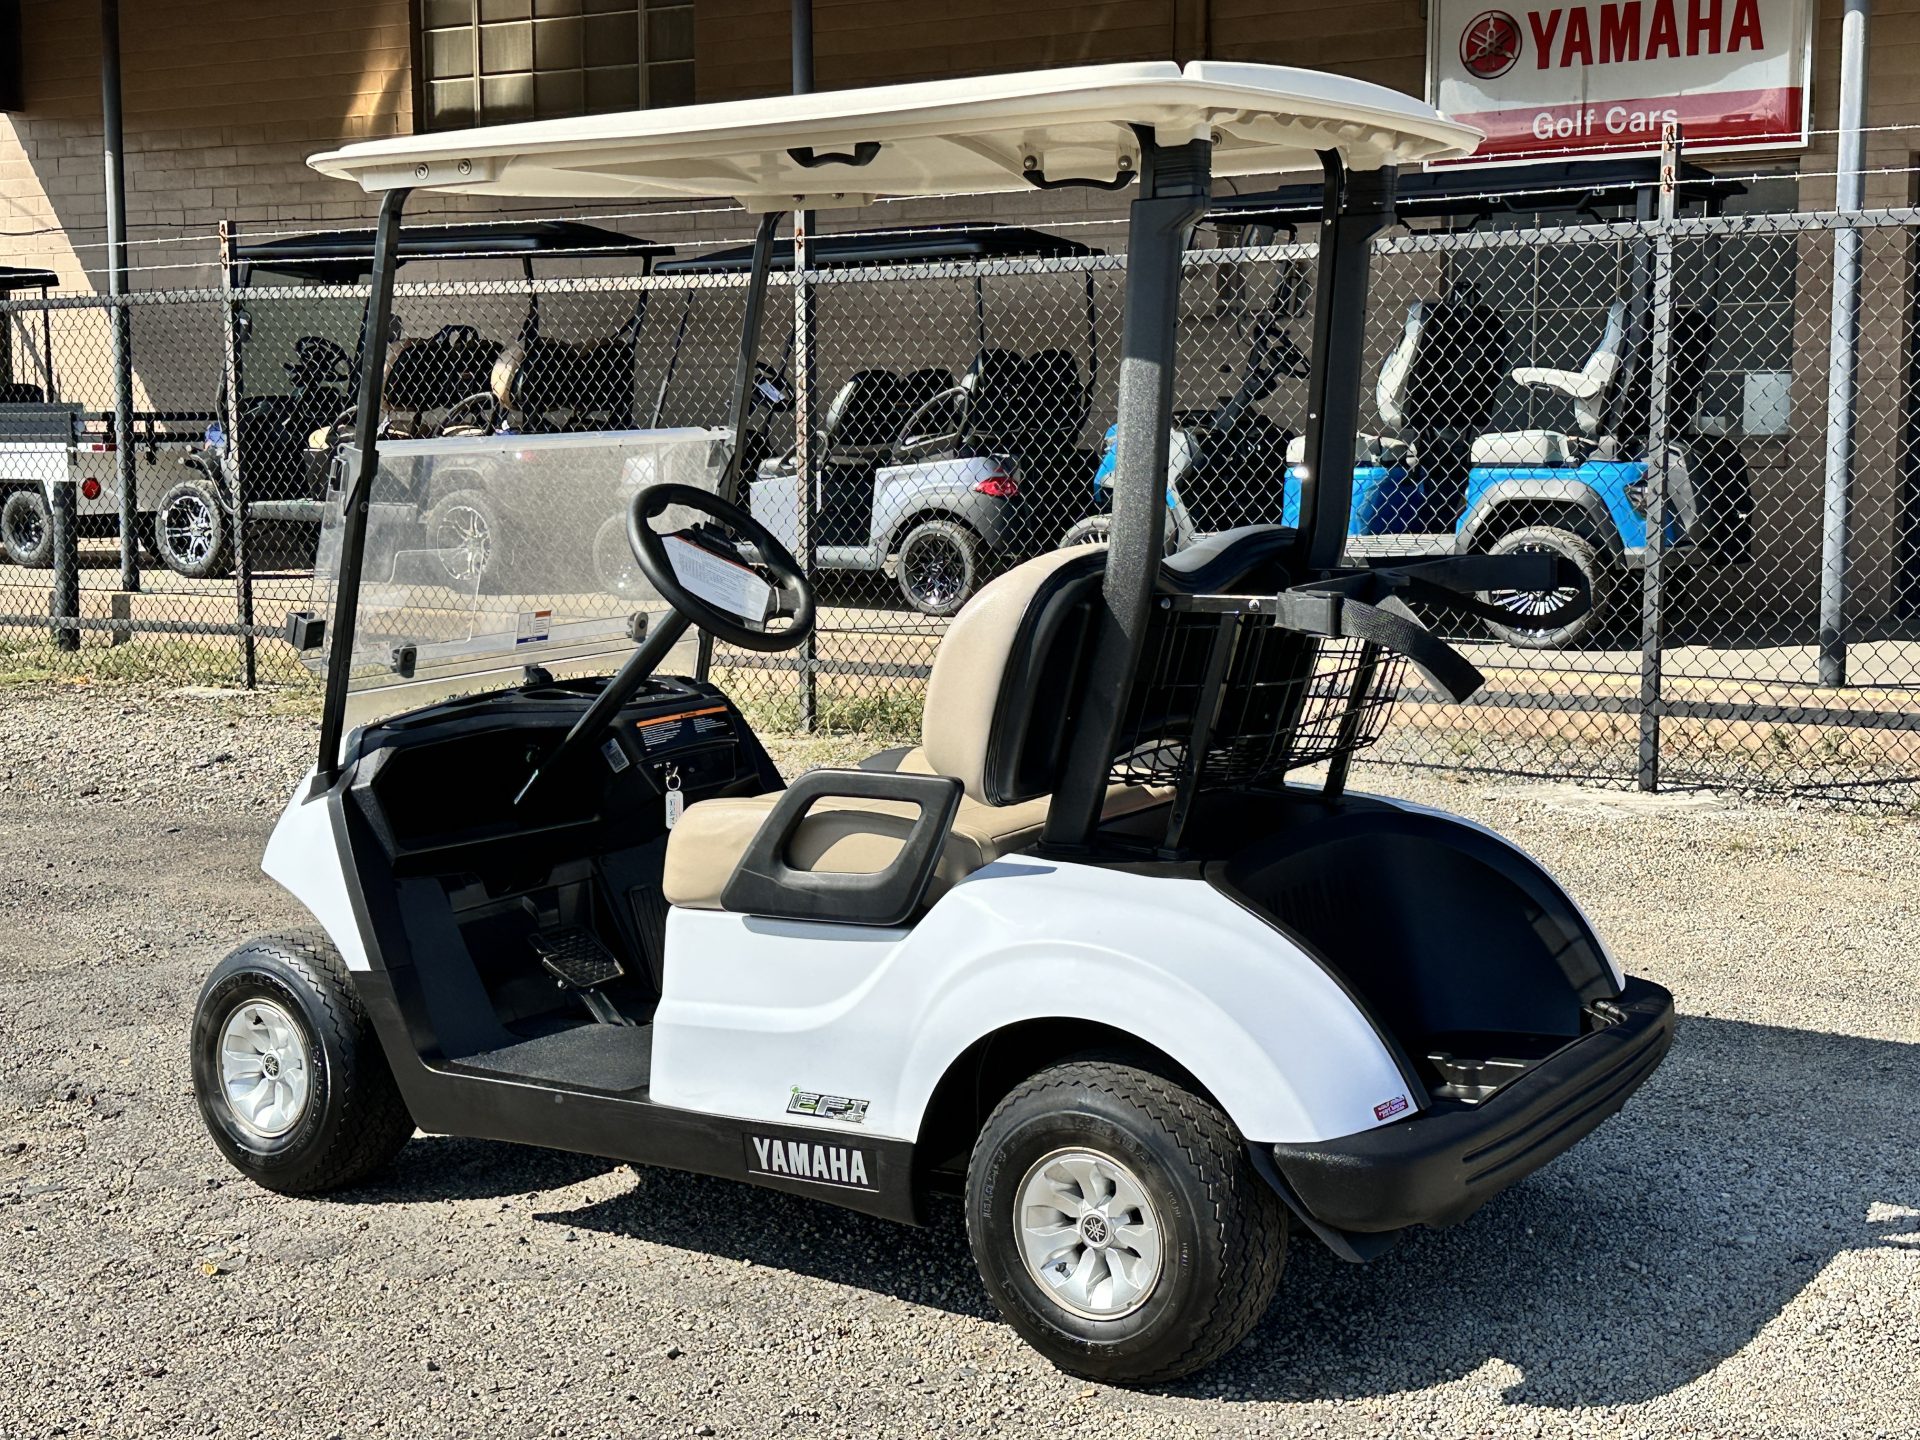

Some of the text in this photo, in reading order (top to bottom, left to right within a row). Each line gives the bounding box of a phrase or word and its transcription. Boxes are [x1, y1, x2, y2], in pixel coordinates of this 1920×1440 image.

[1527, 0, 1765, 70] YAMAHA
[1532, 106, 1678, 140] Golf Cars
[787, 1091, 869, 1117] EFI
[752, 1136, 869, 1185] YAMAHA
